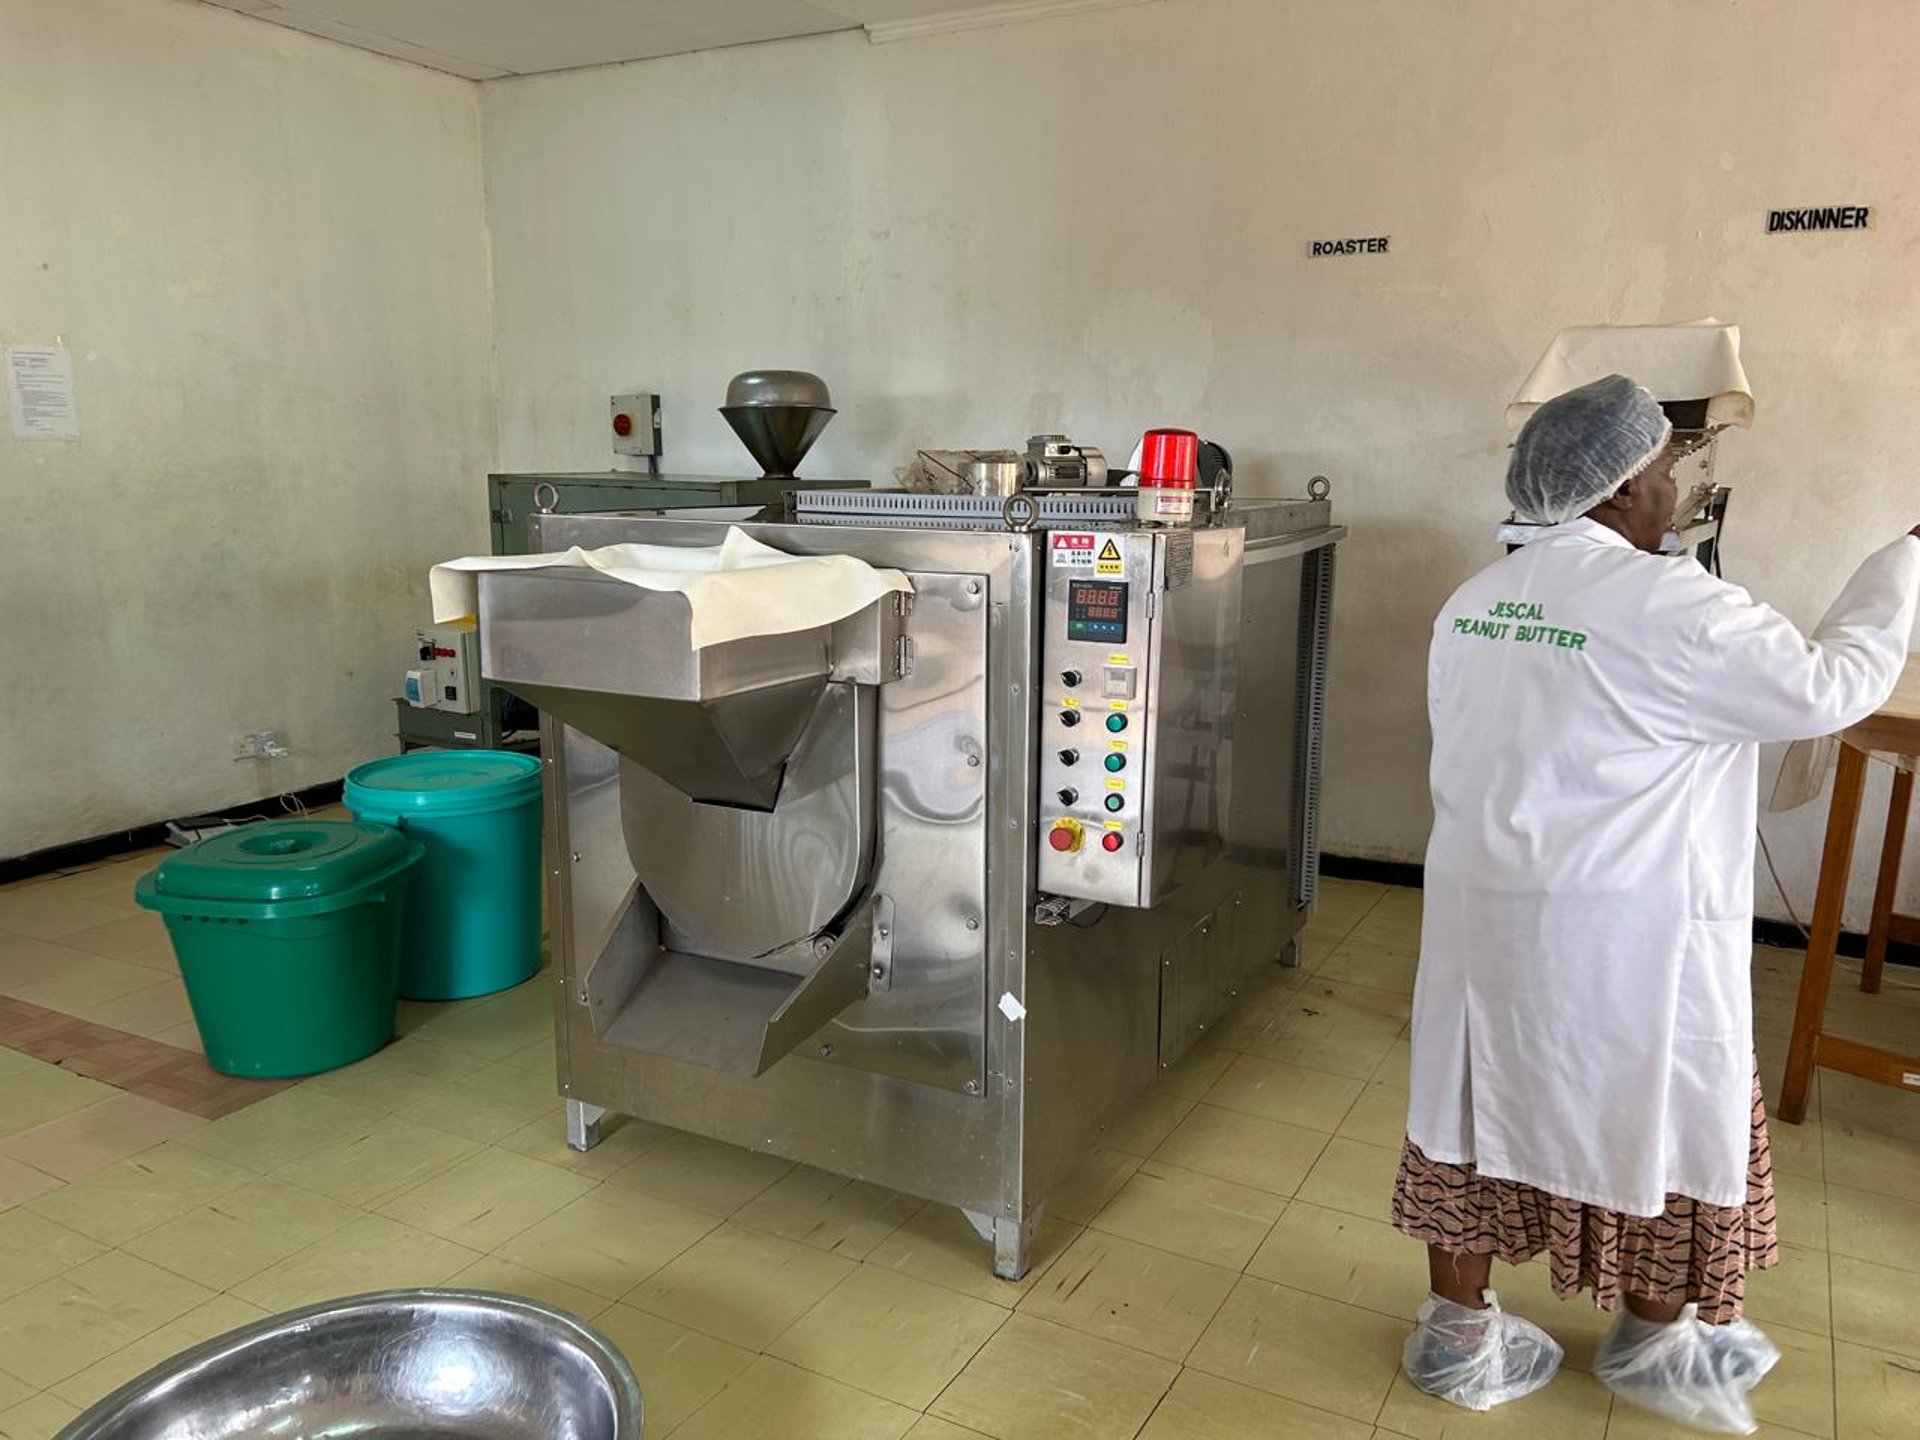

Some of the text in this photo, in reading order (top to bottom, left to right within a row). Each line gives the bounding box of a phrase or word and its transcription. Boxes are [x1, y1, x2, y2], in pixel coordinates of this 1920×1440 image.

[1769, 206, 1868, 231] DISKINNER
[1313, 237, 1388, 255] ROASTER
[1488, 601, 1545, 620] JESCAL
[1452, 618, 1587, 650] PEANUT BUTTER
